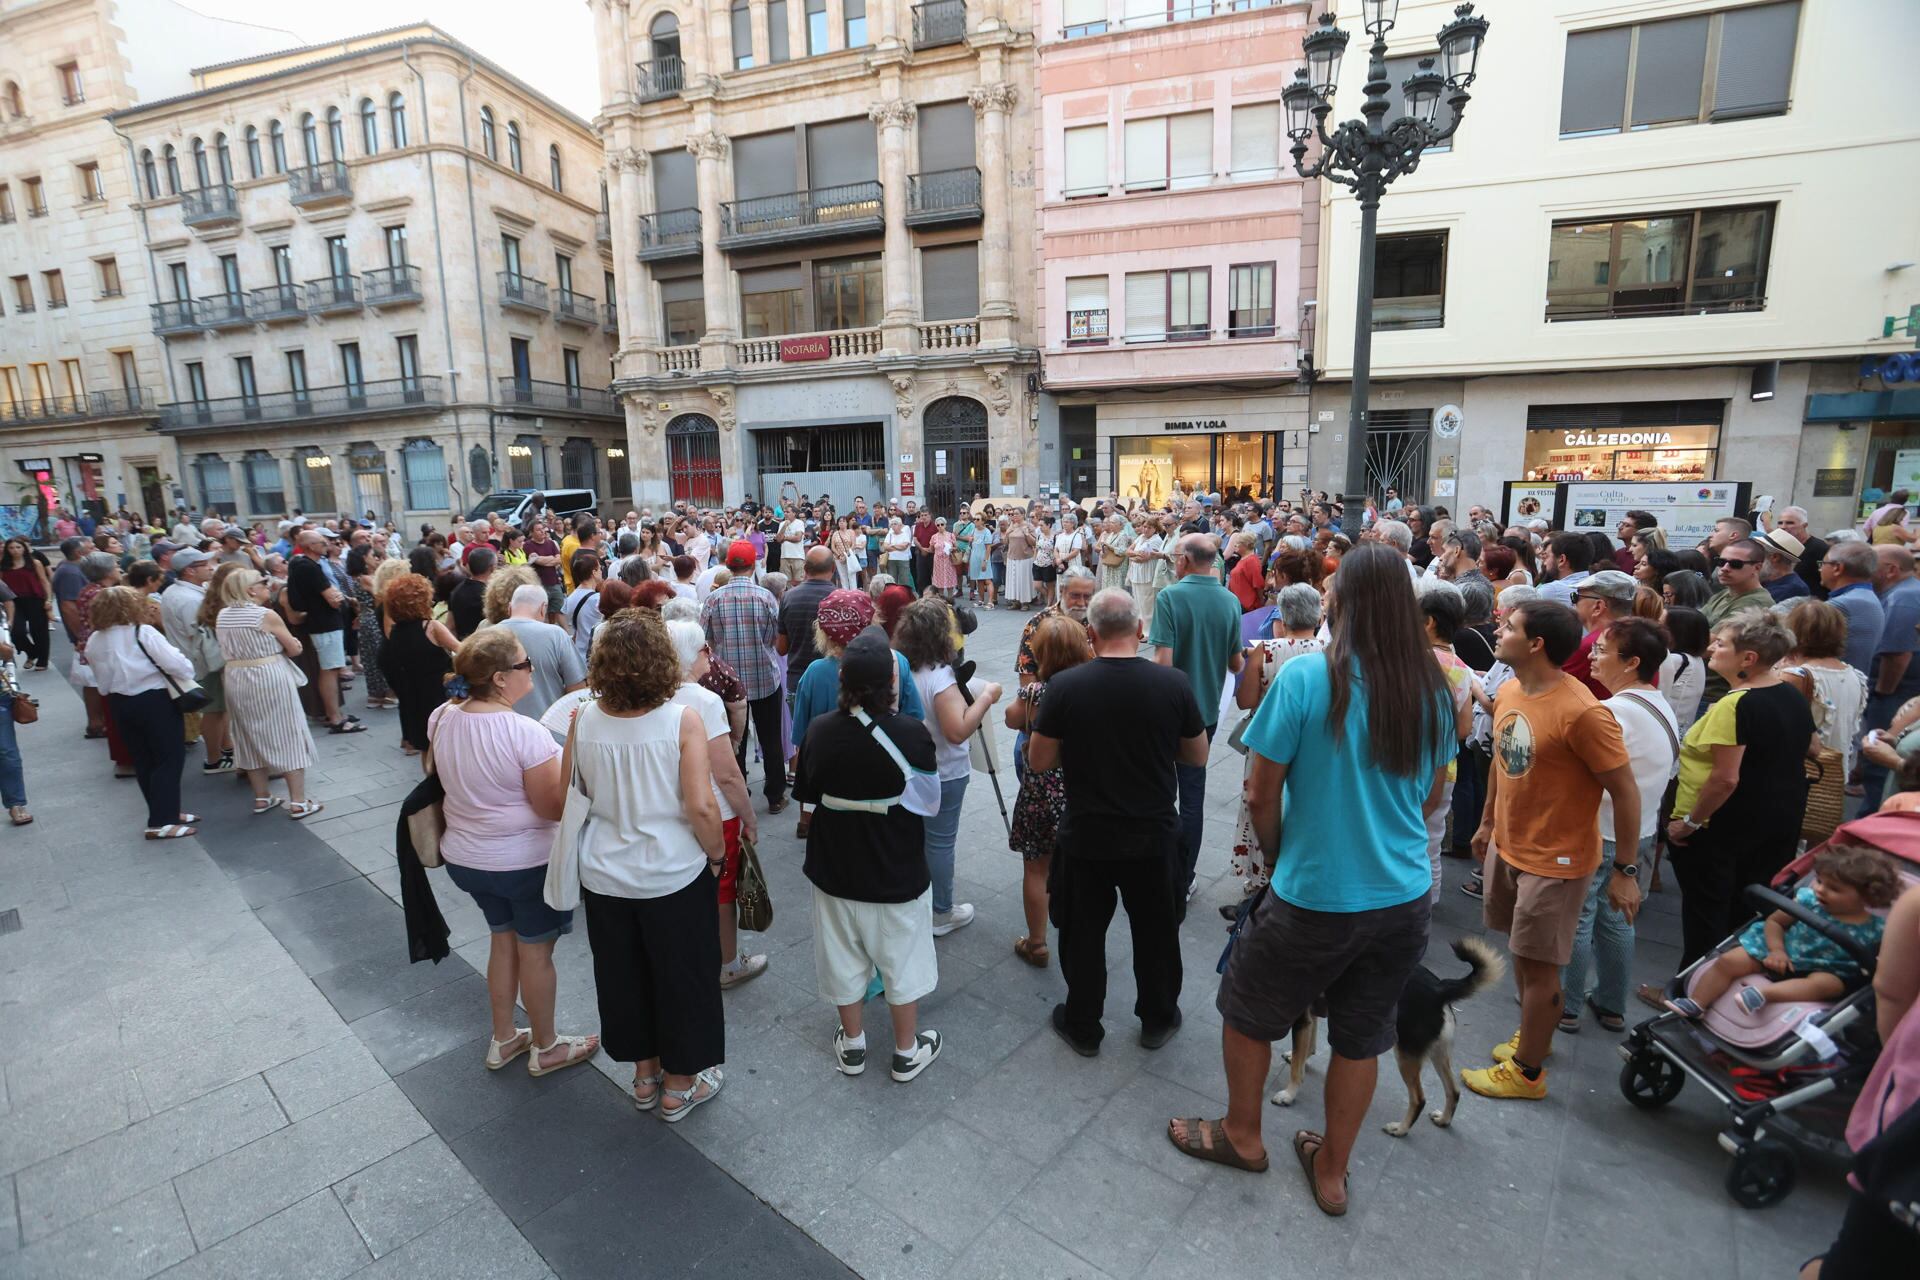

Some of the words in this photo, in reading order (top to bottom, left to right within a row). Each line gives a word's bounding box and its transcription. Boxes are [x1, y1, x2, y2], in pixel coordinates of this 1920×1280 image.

[784, 343, 824, 355] NOTARÍA
[1165, 422, 1193, 430] BIMBA
[1195, 421, 1202, 429] Y
[1203, 420, 1226, 429] LOLA
[1564, 432, 1672, 446] CALZEDONIA
